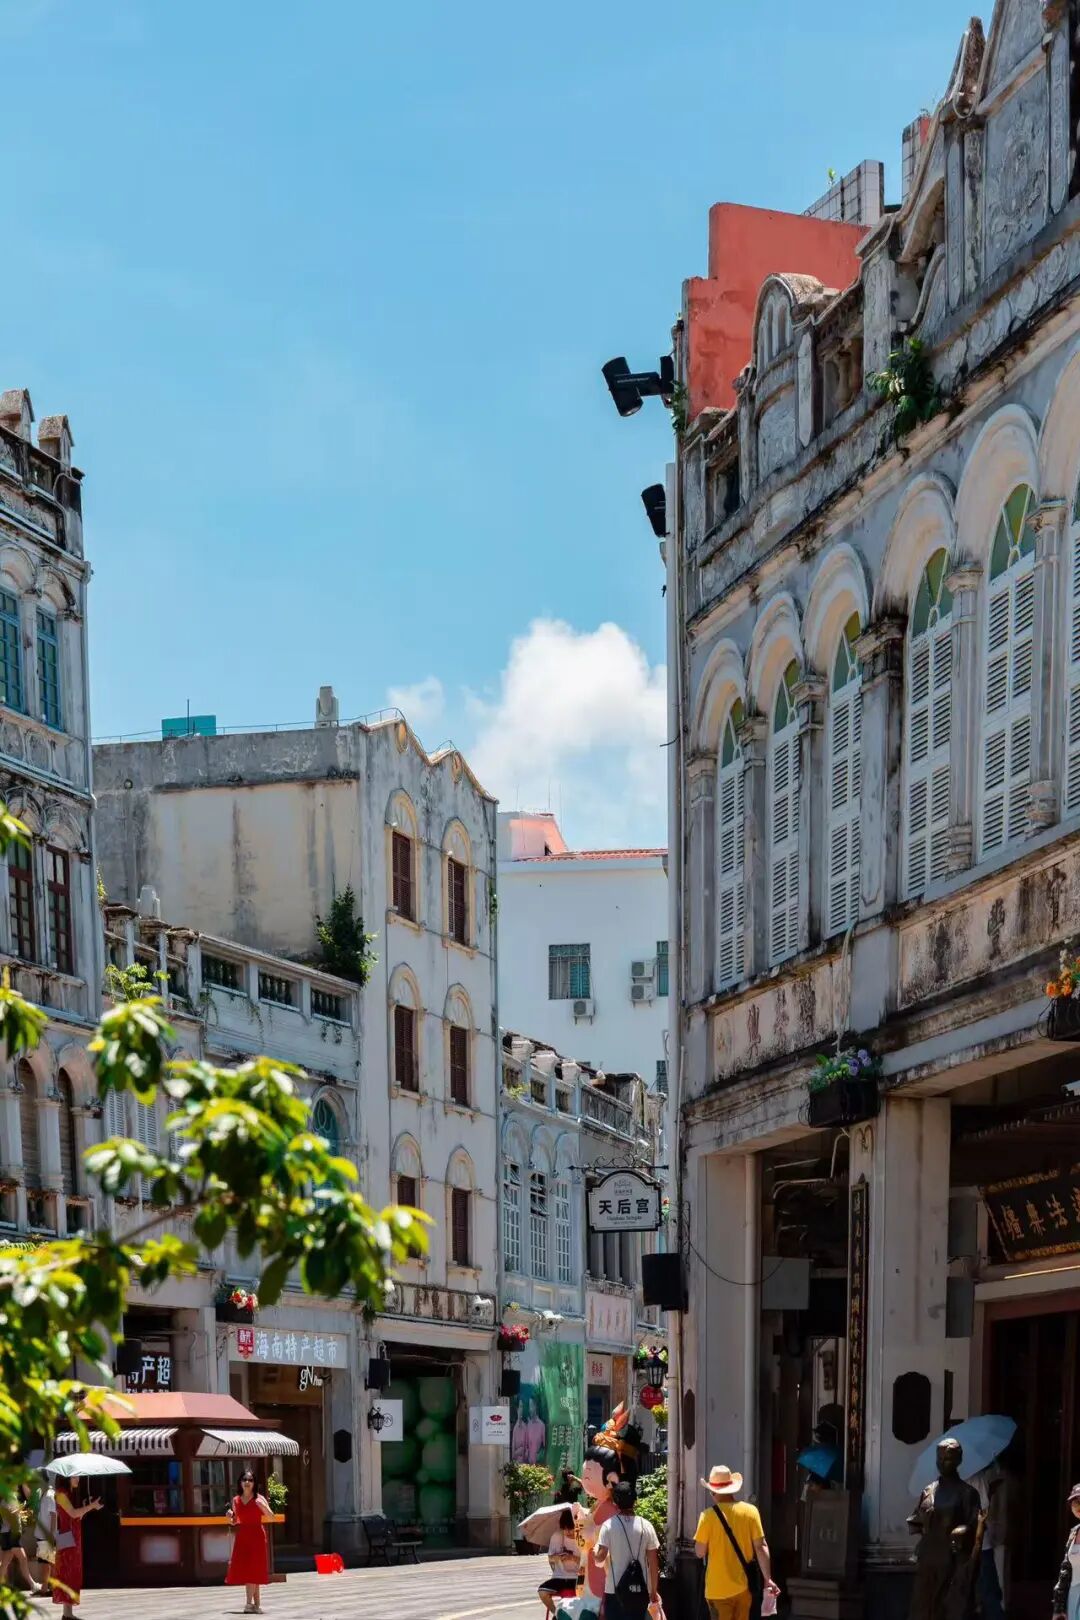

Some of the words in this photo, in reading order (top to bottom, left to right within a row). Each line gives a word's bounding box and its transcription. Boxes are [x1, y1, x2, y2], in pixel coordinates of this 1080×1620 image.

[599, 1198, 649, 1214] 天后宫
[256, 1331, 338, 1364] 海南特产超市
